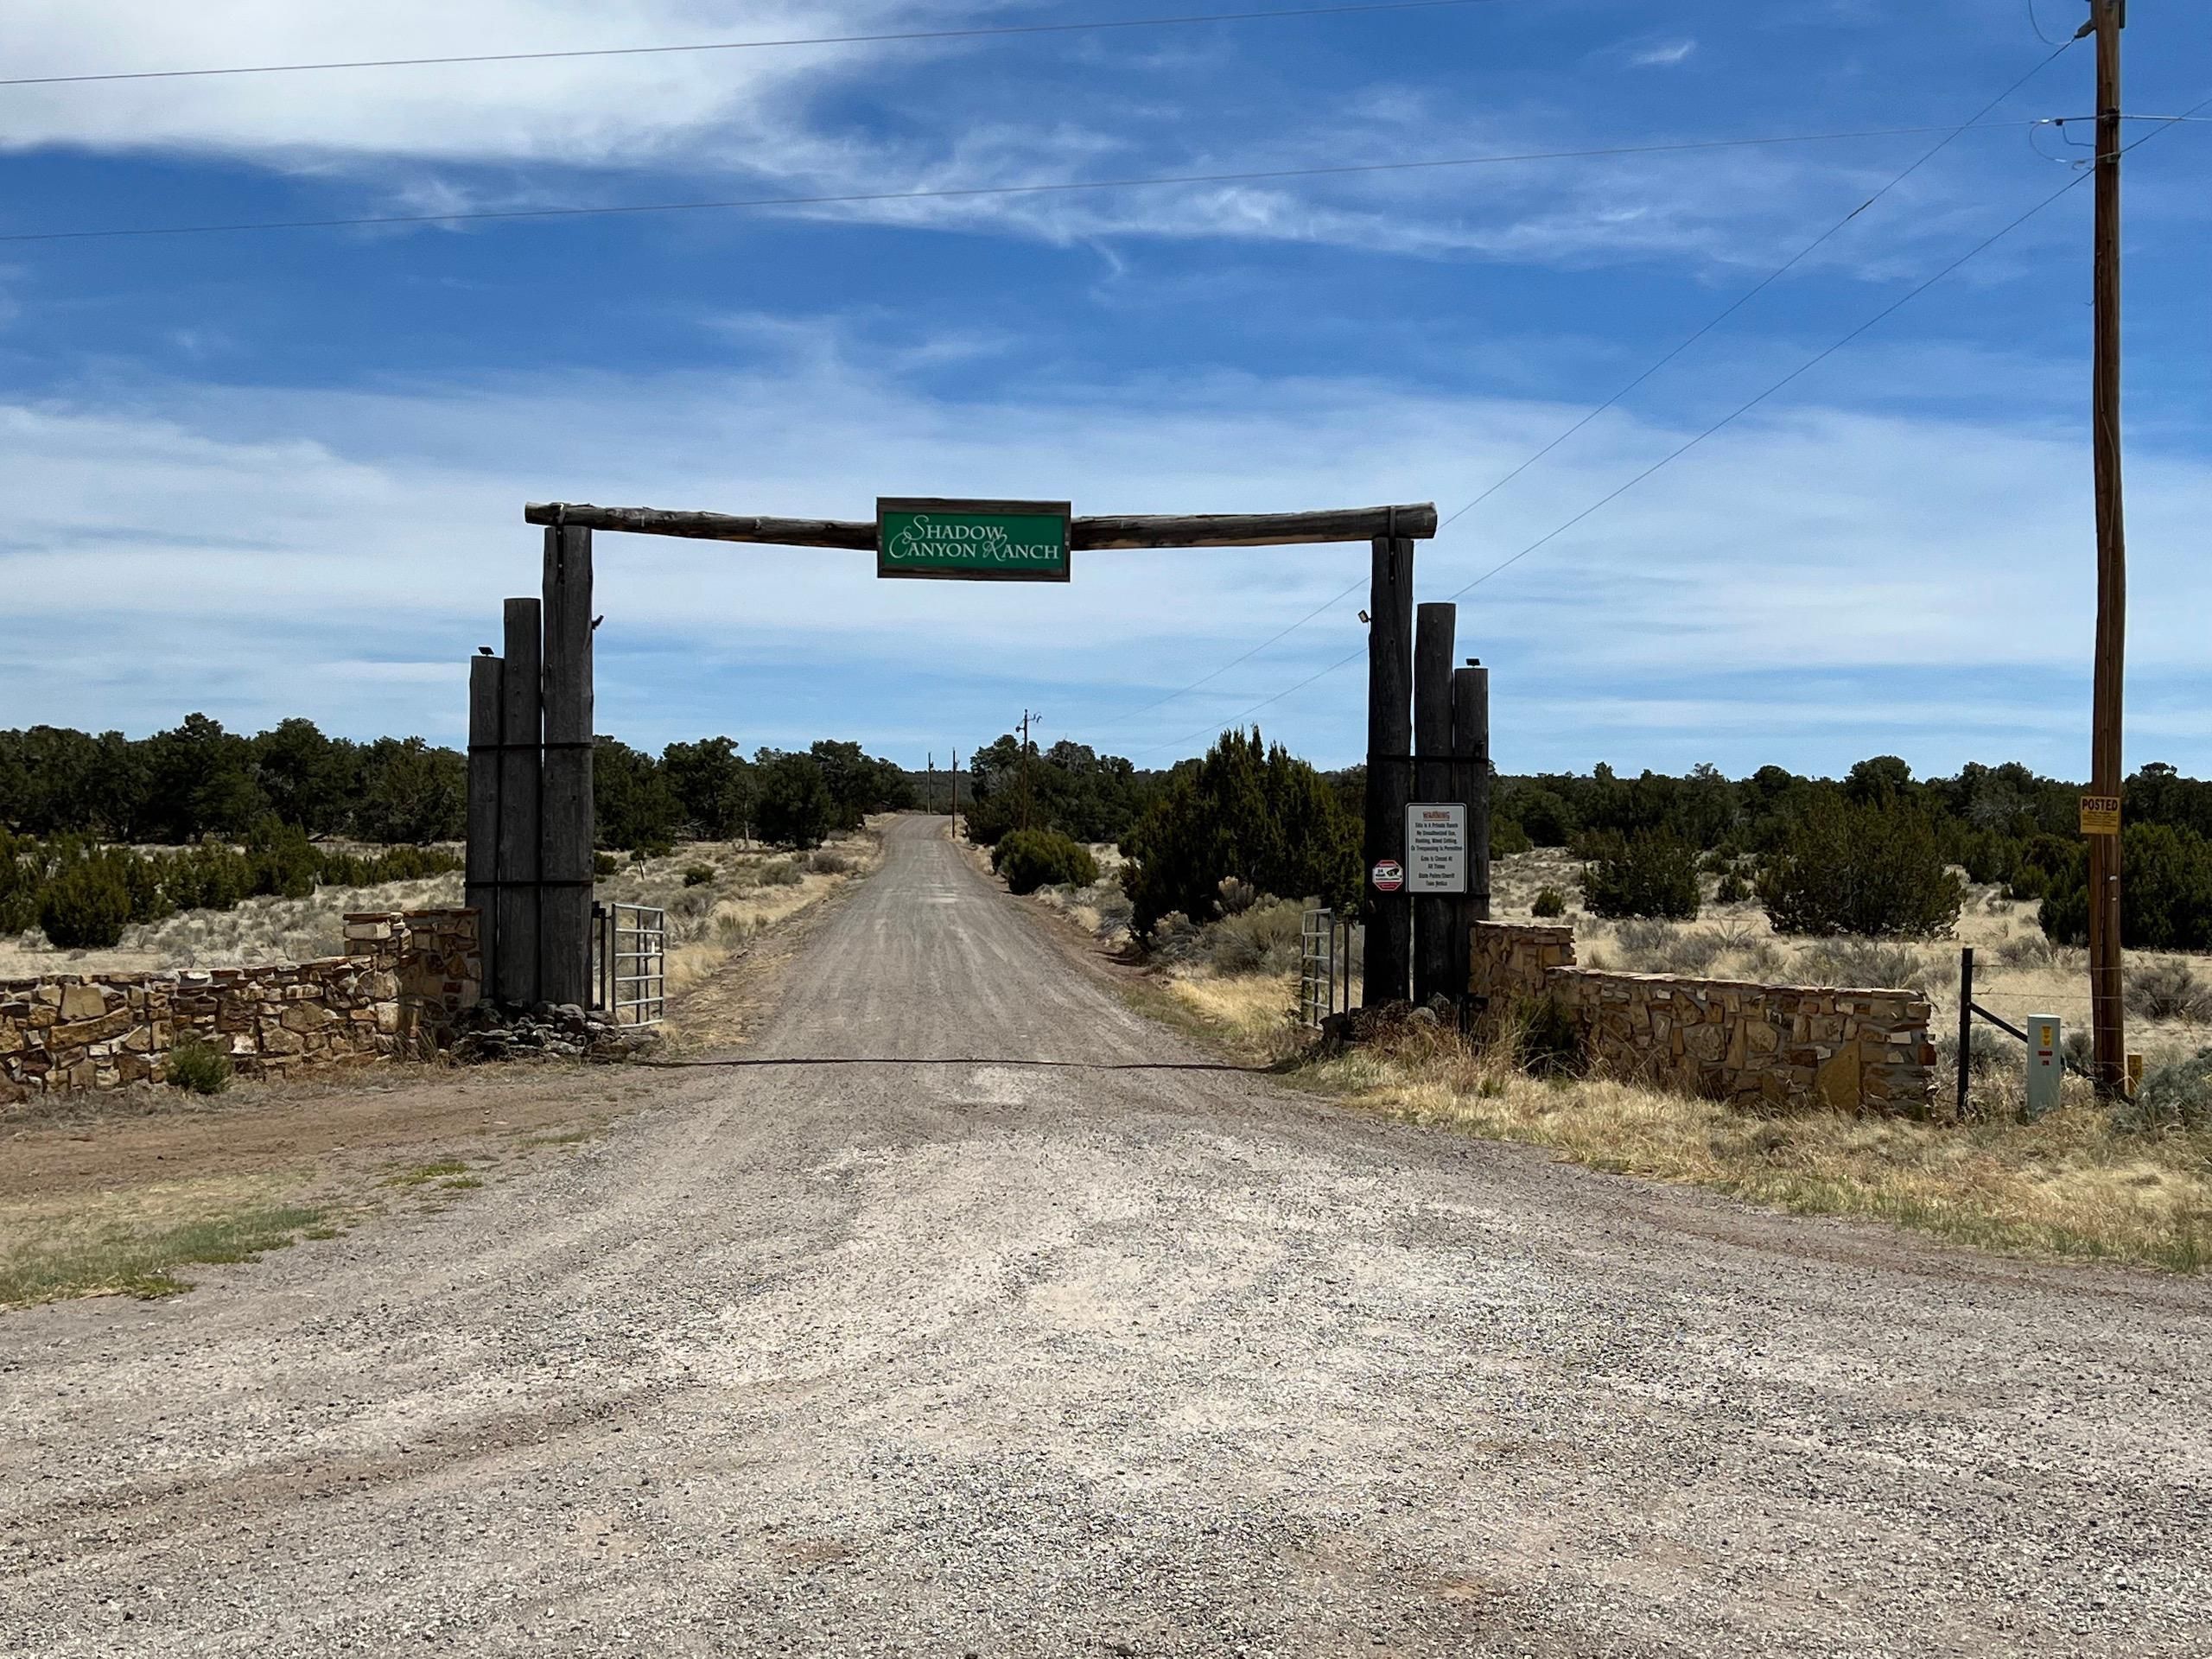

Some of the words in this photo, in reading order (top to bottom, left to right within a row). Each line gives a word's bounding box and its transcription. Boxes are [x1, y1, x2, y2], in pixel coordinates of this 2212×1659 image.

[903, 514, 1005, 541] SHADOW
[889, 531, 977, 559] CANYON
[982, 533, 1059, 562] RANCH
[2082, 798, 2119, 811] POSTED
